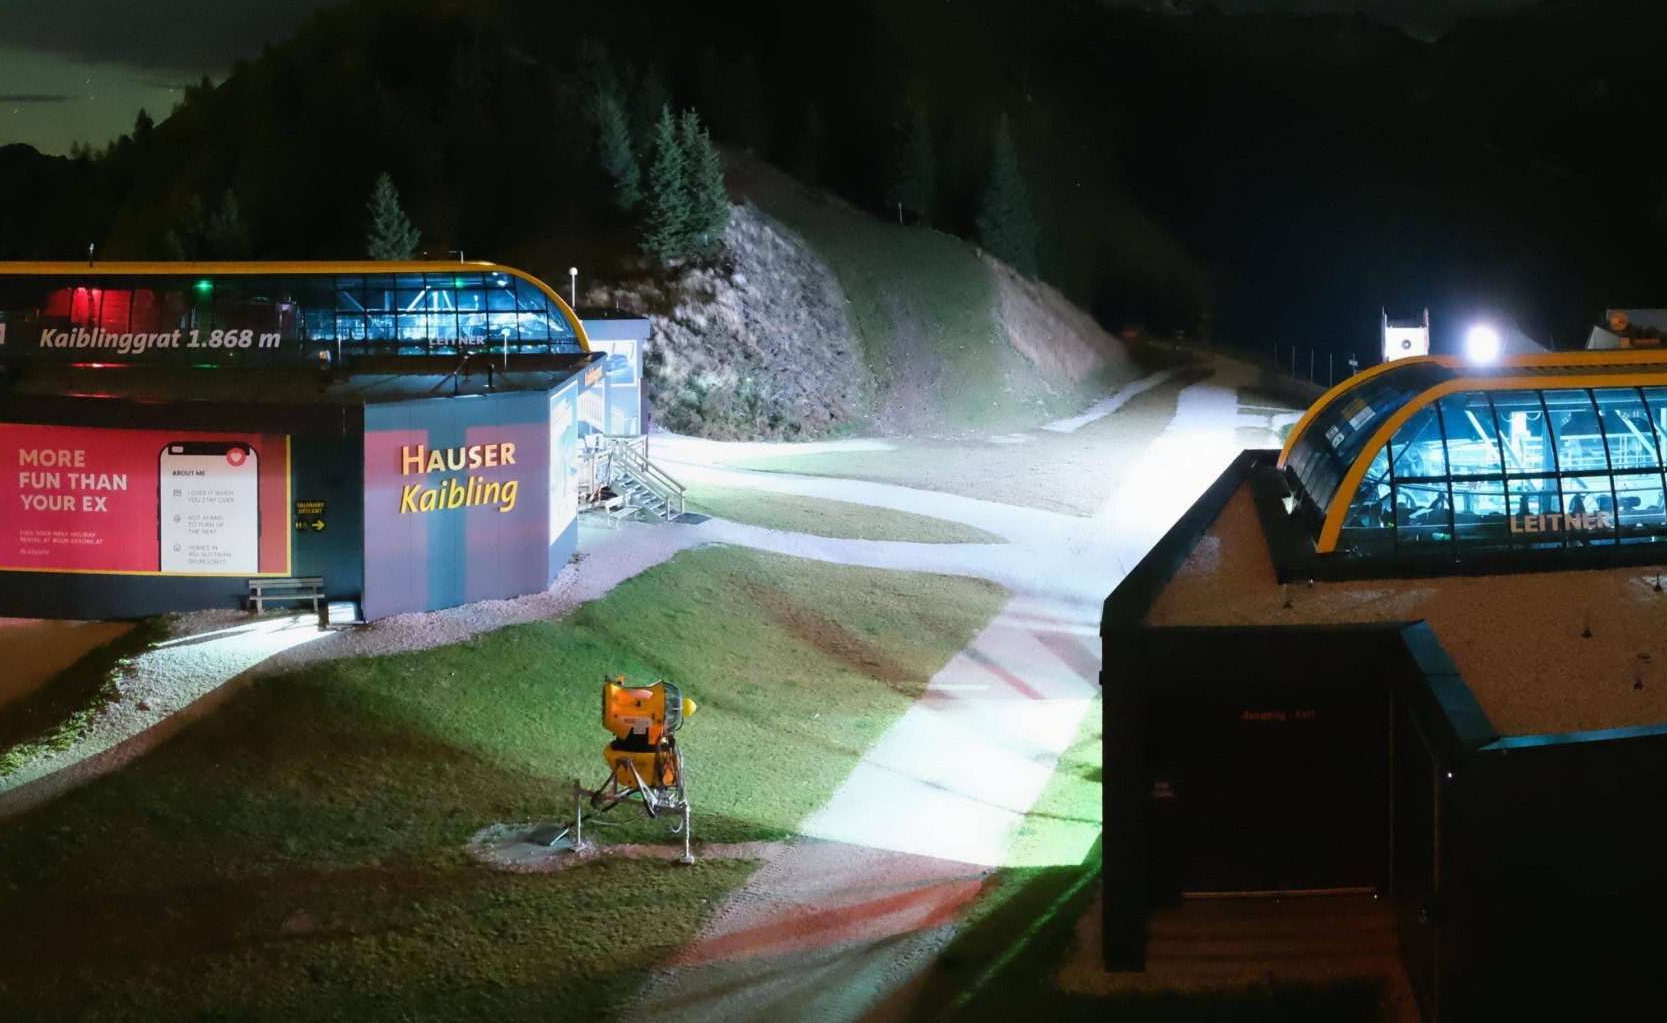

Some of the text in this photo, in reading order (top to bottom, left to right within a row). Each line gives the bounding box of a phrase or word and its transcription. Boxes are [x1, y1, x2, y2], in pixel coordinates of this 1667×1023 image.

[39, 327, 281, 354] Kaiblinggrat 1.868 m
[428, 335, 485, 346] LEITNER
[19, 448, 85, 468] MORE
[402, 442, 517, 476] HAUSER
[19, 472, 127, 491] FUN THAN
[20, 494, 108, 512] YOUR EX
[399, 476, 519, 514] Kaibling
[1510, 511, 1613, 533] LEITNER
